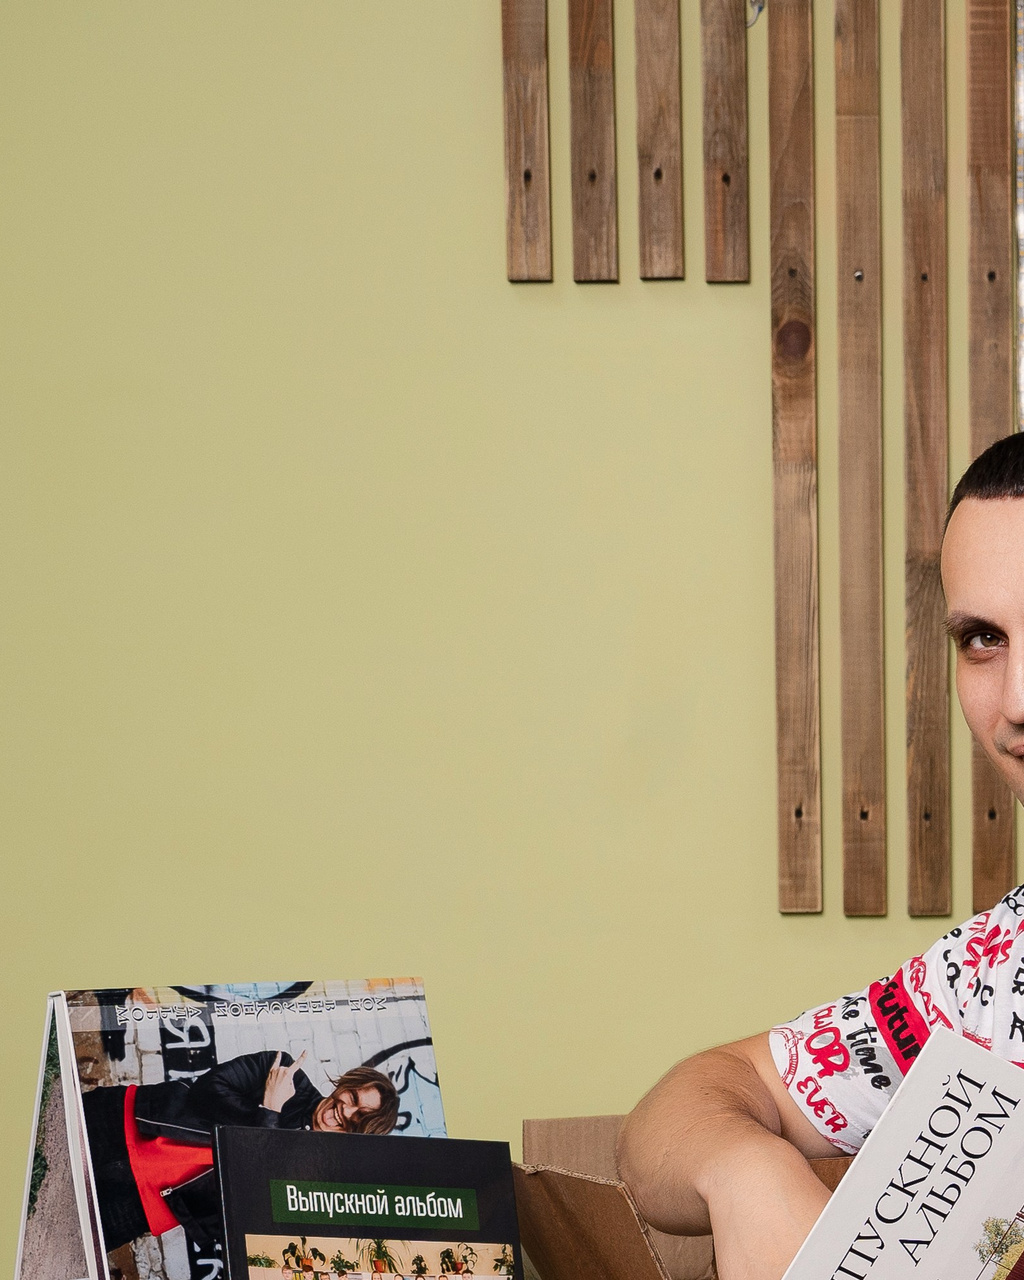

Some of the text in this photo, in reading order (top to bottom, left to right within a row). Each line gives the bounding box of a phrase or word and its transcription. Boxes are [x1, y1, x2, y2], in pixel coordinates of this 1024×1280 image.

[286, 1184, 464, 1219] Выпускной альбом
[898, 1085, 1022, 1267] АЛЬБОМ
